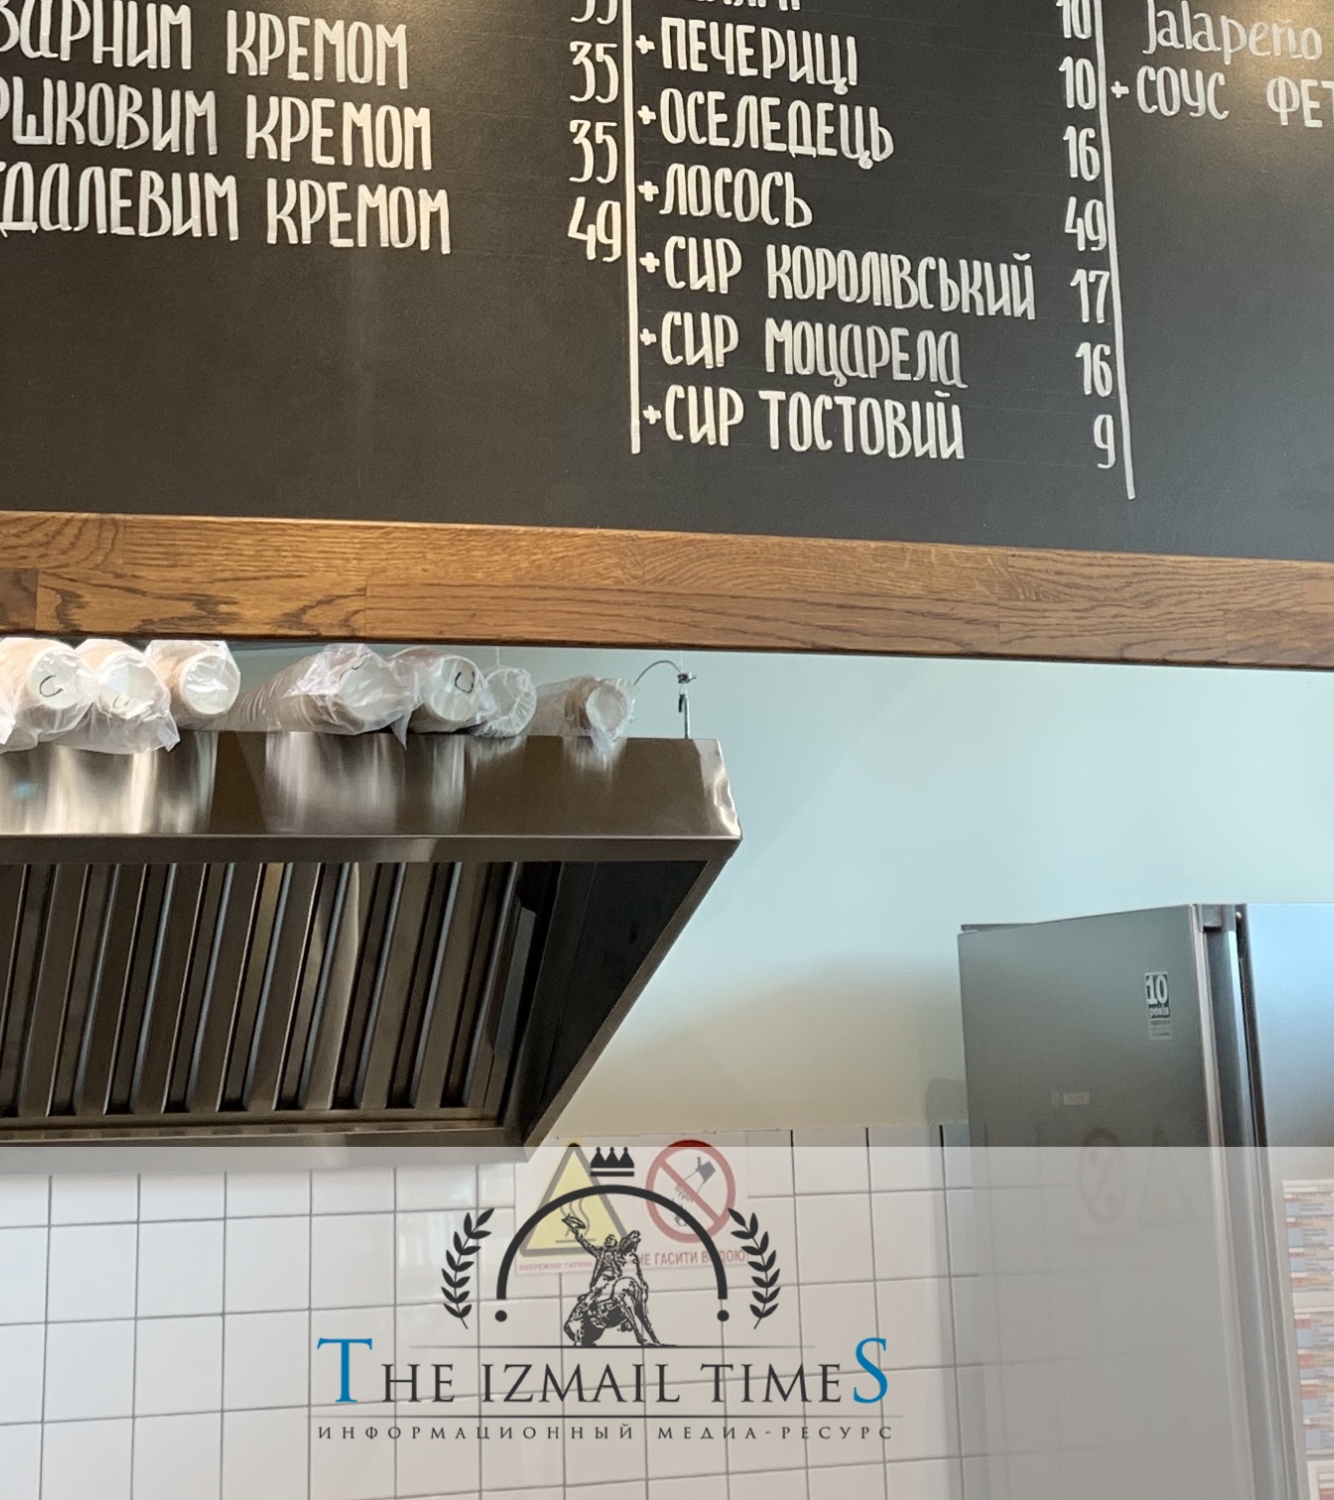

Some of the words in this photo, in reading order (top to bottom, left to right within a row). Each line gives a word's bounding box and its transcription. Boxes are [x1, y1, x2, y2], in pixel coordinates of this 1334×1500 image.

[226, 8, 408, 90] КРЕМОМ
[569, 40, 620, 104] 35
[1058, 55, 1097, 110] 10
[245, 94, 432, 171] КРЕМОМ
[569, 118, 619, 184] 35
[1062, 125, 1101, 181] 16
[266, 177, 451, 255] КРЕМОМ
[567, 196, 622, 262] 49
[1064, 196, 1108, 252] 49
[766, 243, 1037, 320] КОРОЛІВСЬКИЙ
[1069, 269, 1110, 324] 17
[765, 317, 968, 388] МОЦАРЕЛА
[1075, 341, 1114, 399] 16
[757, 389, 966, 460] ТОСТОВИЙ
[1092, 413, 1117, 469] 9
[654, 1251, 698, 1266] ГАСИТИ
[701, 1249, 750, 1264] ВДОЮ!
